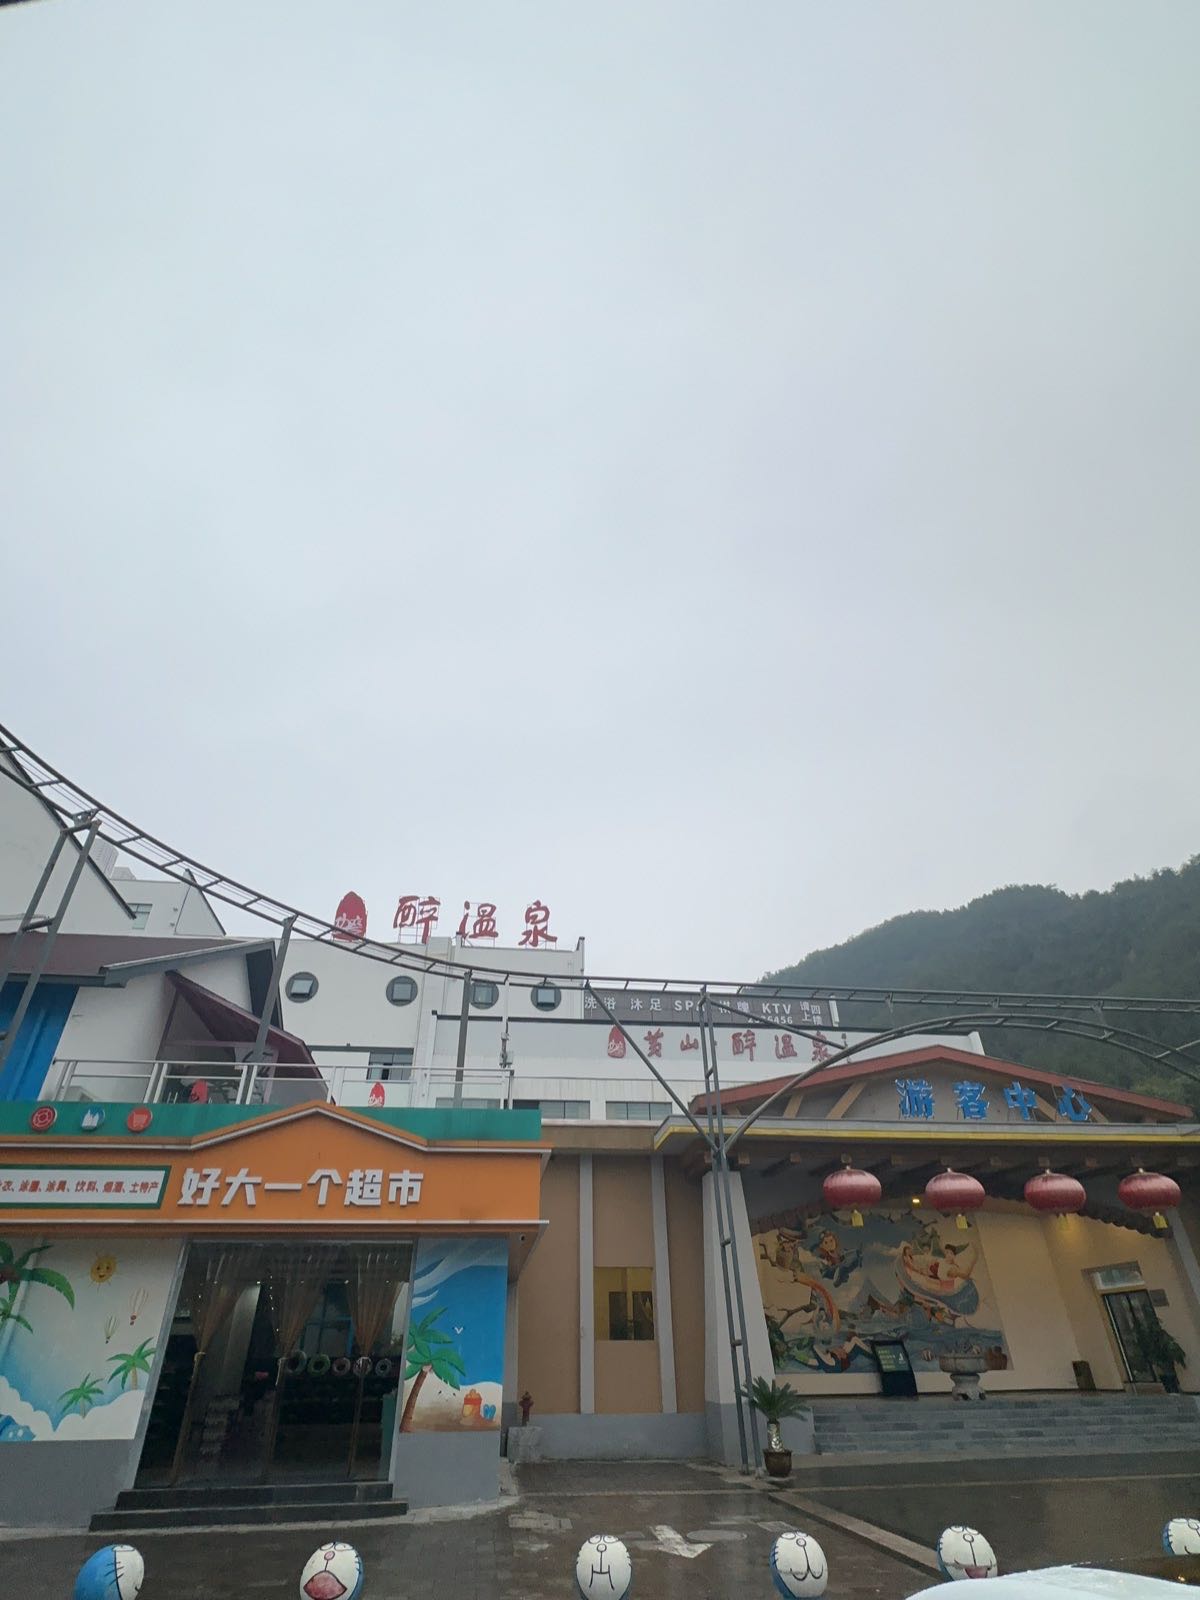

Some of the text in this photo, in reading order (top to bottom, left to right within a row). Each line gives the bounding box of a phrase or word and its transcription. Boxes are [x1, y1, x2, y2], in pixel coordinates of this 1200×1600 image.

[393, 895, 558, 947] 醉温泉
[630, 998, 662, 1011] 沐足
[762, 1002, 792, 1015] KTV
[895, 1079, 1092, 1121] 游客中心
[177, 1167, 424, 1207] 好大一个超市
